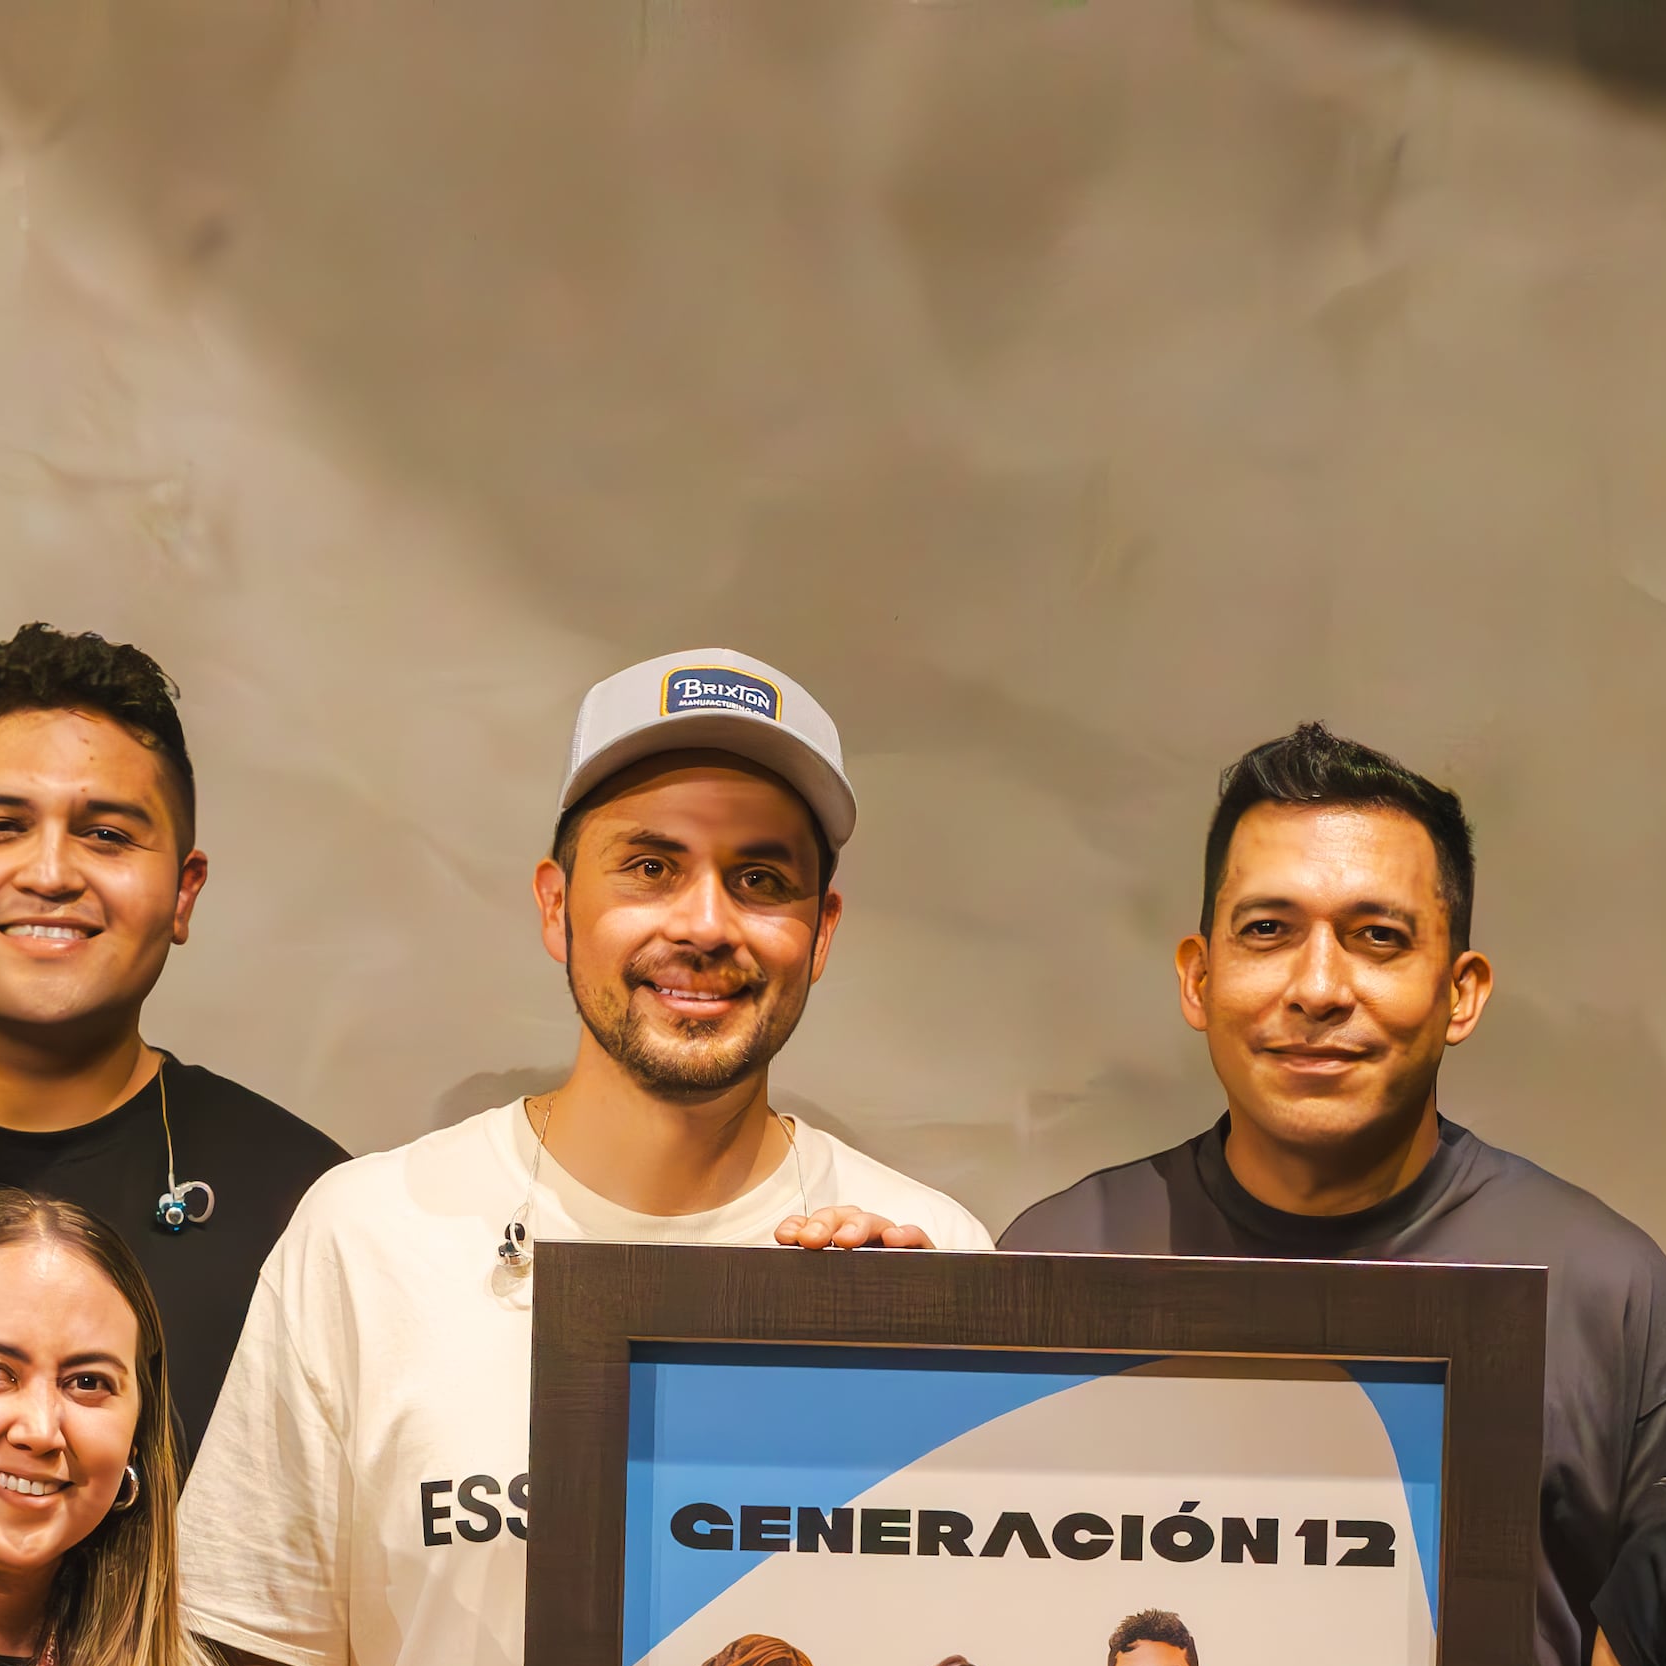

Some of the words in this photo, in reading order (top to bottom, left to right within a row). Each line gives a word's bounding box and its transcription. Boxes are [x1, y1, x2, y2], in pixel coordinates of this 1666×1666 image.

[673, 679, 770, 710] BRIXTON
[670, 1501, 1278, 1564] GENERACIÓN
[1295, 1518, 1396, 1567] 12
